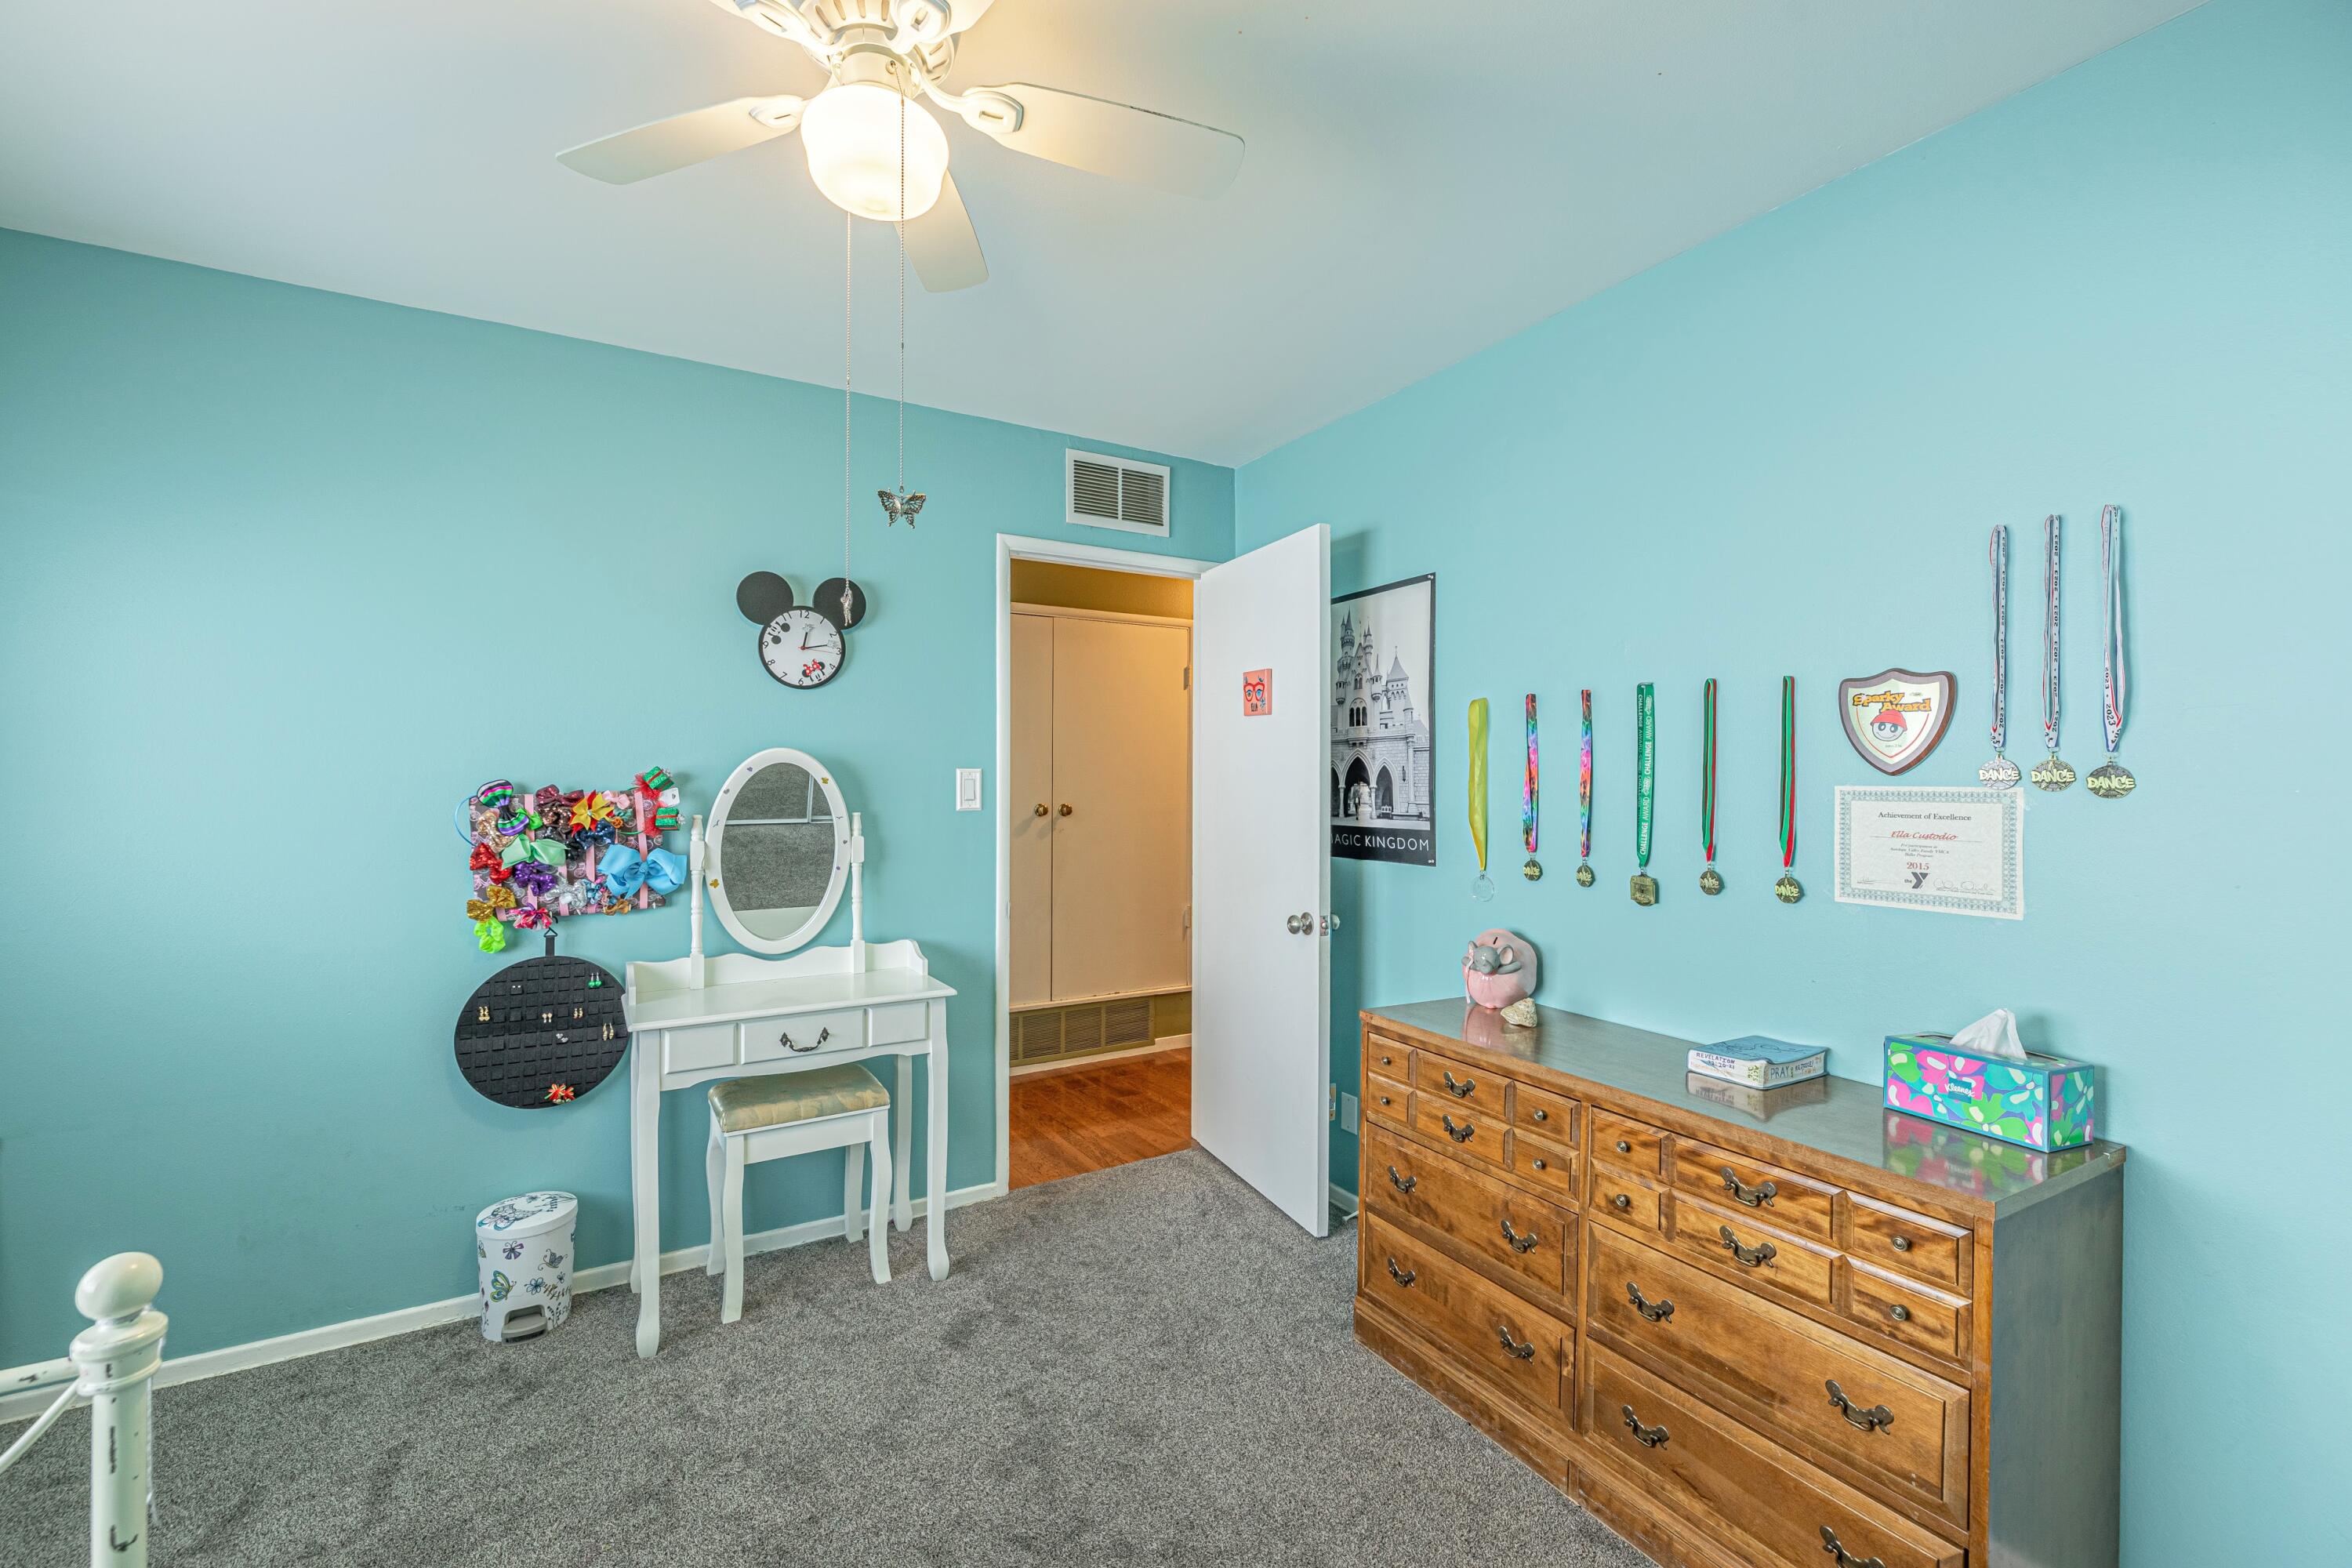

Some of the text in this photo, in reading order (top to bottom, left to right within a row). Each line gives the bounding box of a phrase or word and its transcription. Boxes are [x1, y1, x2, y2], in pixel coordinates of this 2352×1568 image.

[782, 612, 792, 621] 11
[800, 610, 810, 619] 12
[763, 641, 768, 649] 9
[836, 647, 841, 655] 3
[779, 671, 788, 680] 7
[798, 677, 804, 686] 6
[1853, 691, 1904, 706] Sparky
[1880, 698, 1932, 713] Award
[2106, 703, 2116, 726] 2023
[1978, 768, 2021, 781] DANCE
[2031, 768, 2076, 782] DANCE
[2086, 774, 2136, 789] DANCE
[1639, 822, 1649, 855] CHALLENGE
[1913, 832, 1958, 840] Custodio
[1365, 835, 1429, 851] KINGDOM
[1907, 862, 1929, 870] 2015
[1774, 884, 1800, 897] DANCE
[1696, 1052, 1735, 1064] REVELATION
[1770, 1065, 1790, 1079] PRAY
[1944, 1083, 1976, 1098] Kleenex
